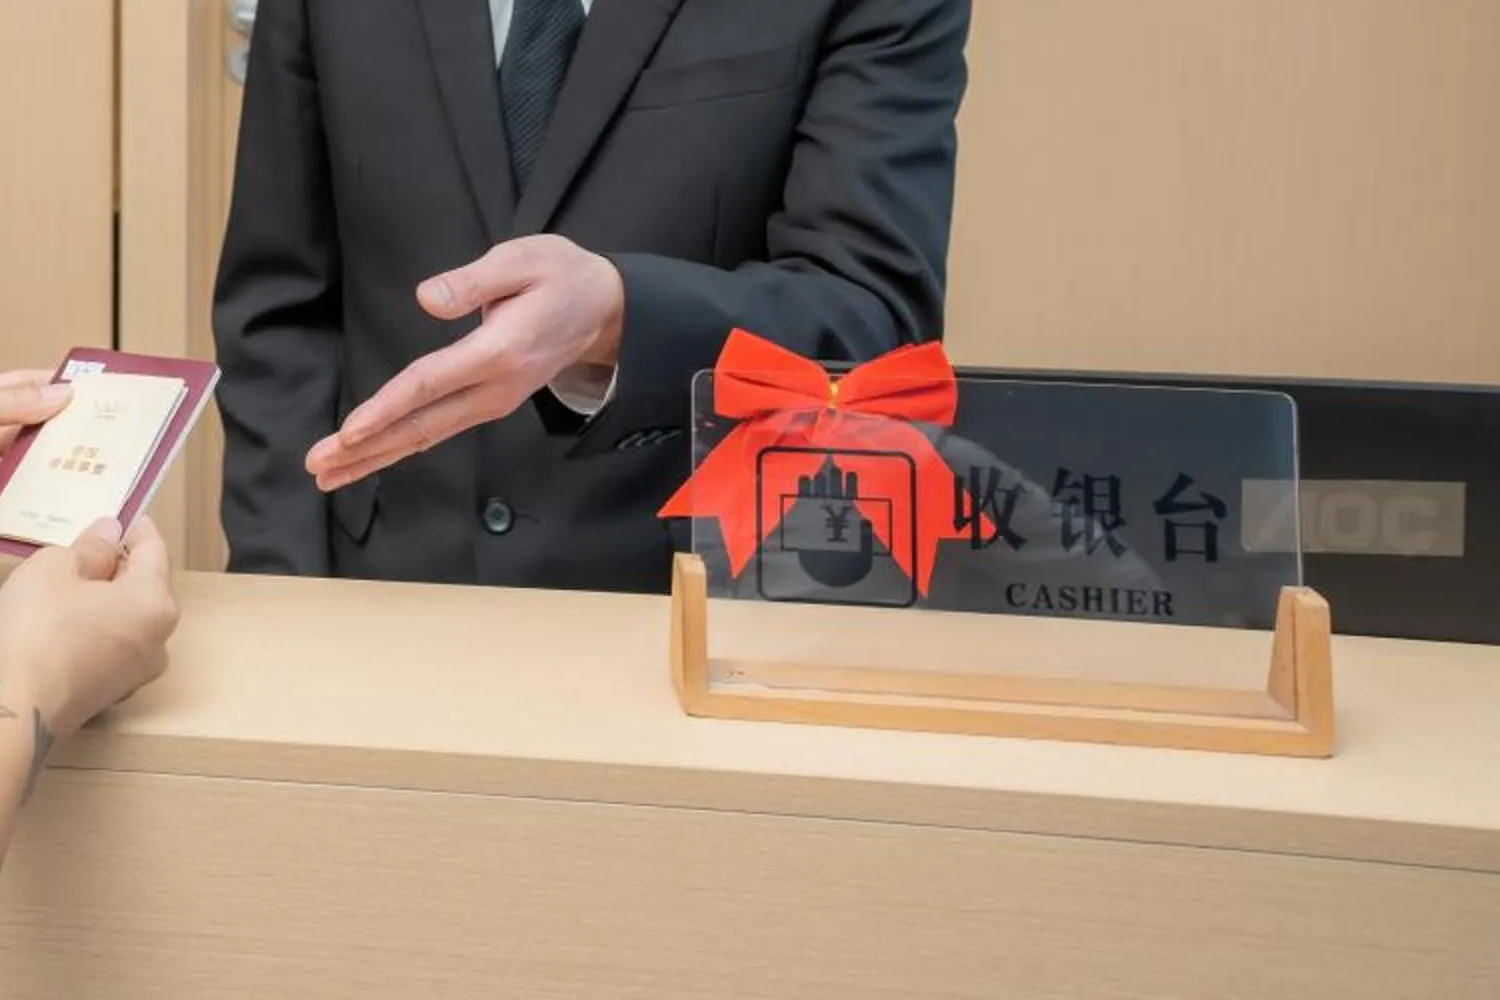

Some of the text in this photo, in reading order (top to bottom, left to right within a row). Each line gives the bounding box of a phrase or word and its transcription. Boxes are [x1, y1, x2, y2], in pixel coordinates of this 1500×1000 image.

[952, 466, 1228, 563] 收银台
[1004, 582, 1175, 616] CASHIER
